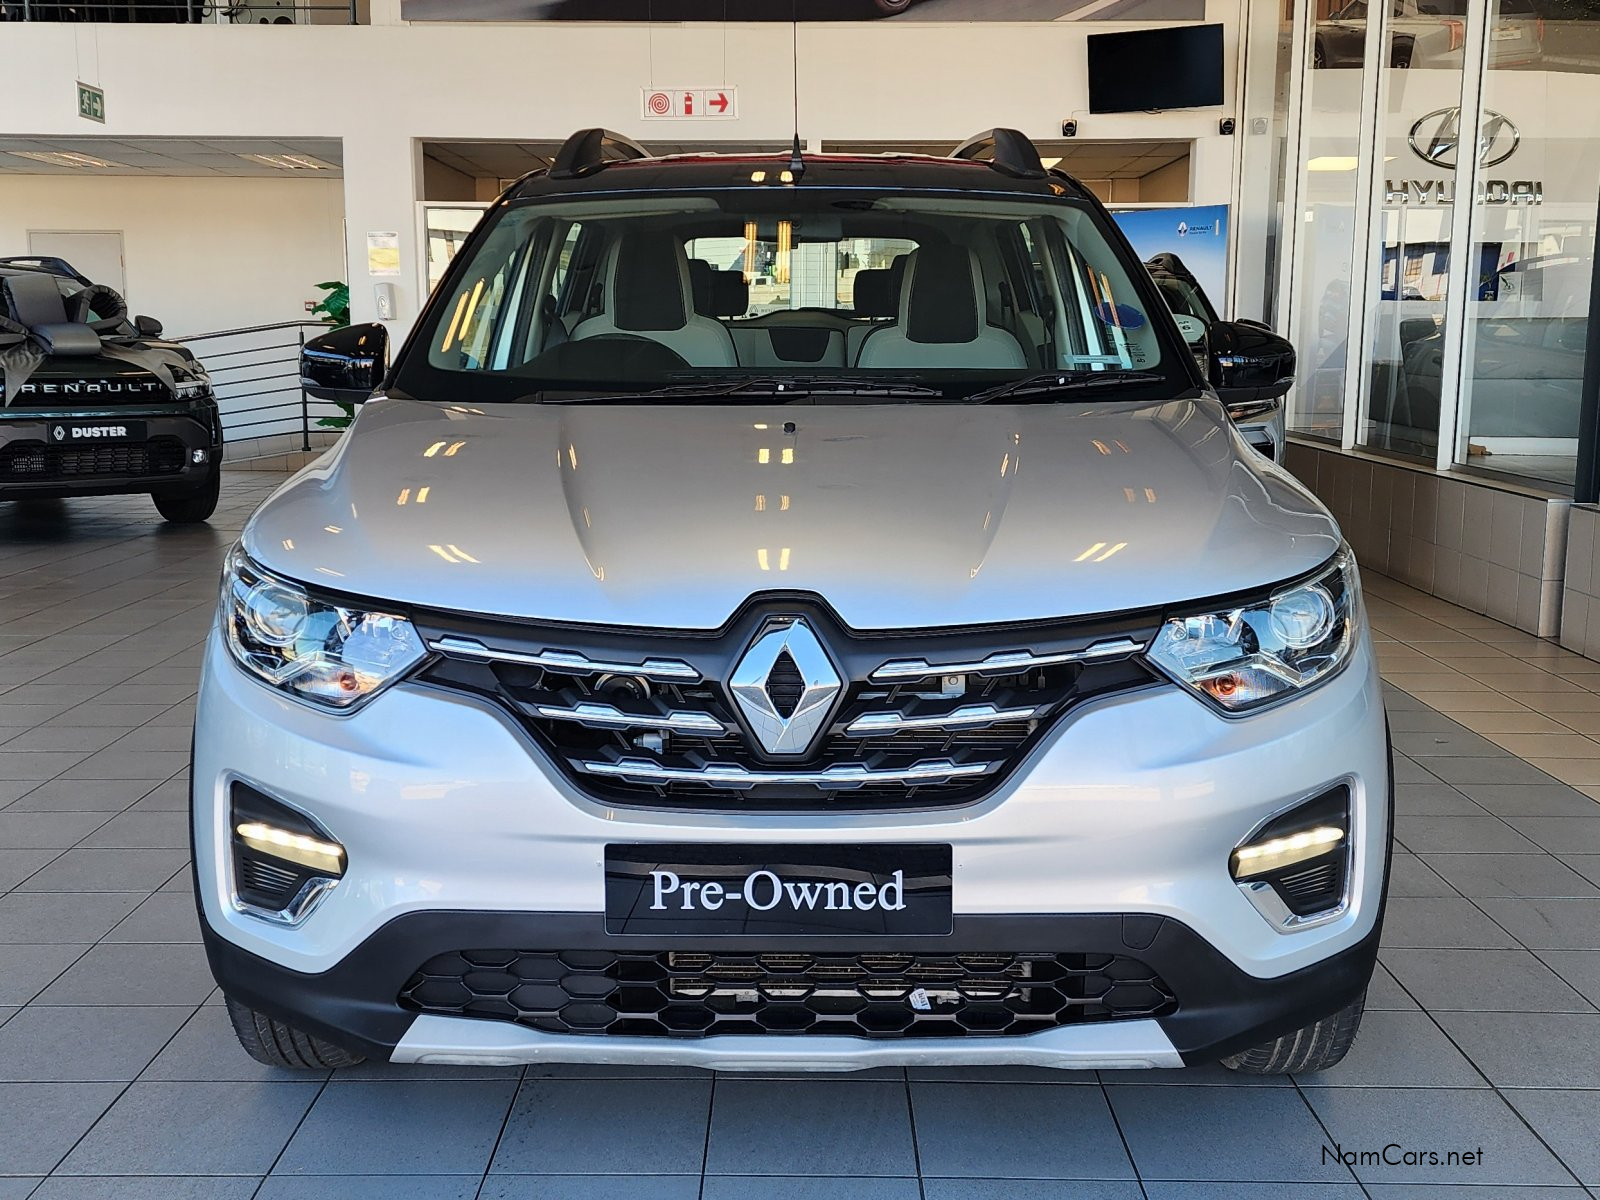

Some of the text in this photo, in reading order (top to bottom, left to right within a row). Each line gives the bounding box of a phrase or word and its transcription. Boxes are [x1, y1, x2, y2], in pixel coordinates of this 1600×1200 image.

[21, 383, 157, 394] RENAULT
[71, 426, 127, 438] DUSTER
[649, 869, 907, 911] Pre-Owned
